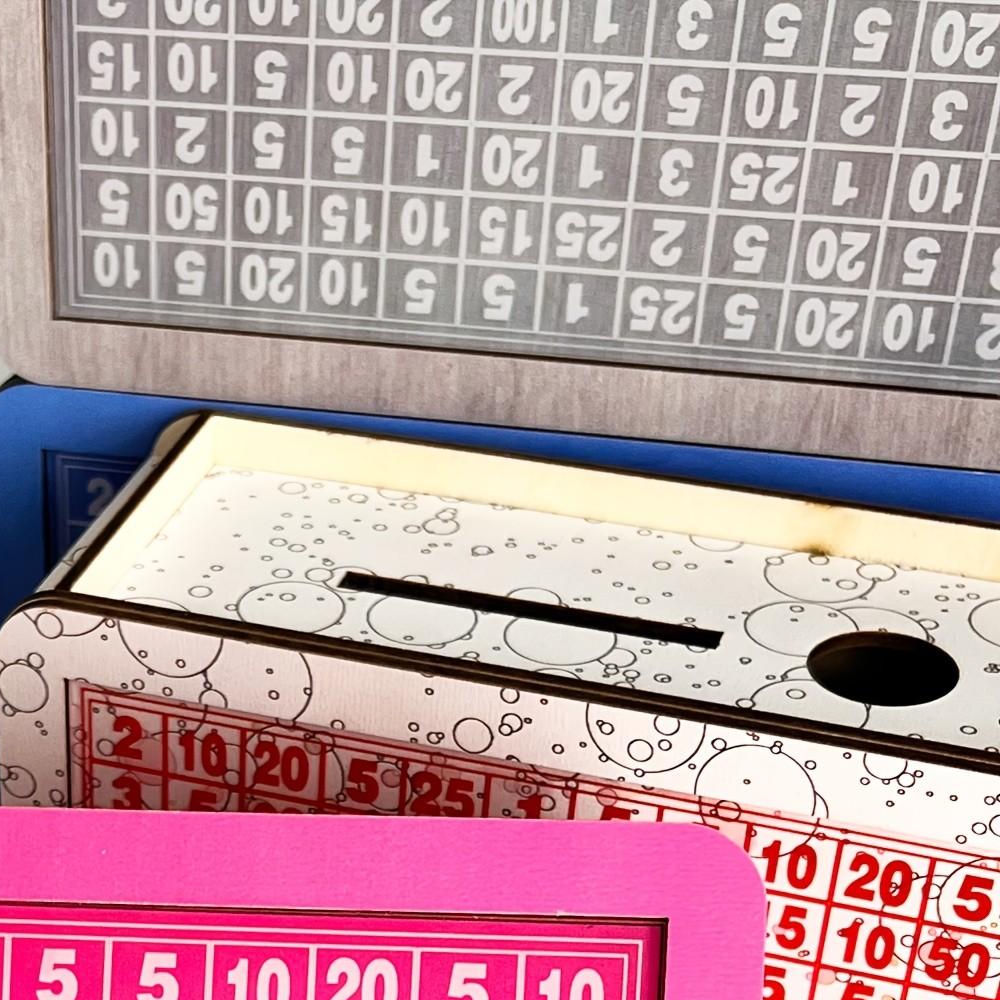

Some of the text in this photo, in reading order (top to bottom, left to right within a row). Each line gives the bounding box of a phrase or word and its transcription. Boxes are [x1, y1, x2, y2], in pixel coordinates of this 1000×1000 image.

[91, 107, 964, 214] 10 1 25 3 1 20 1 5 5 2 10
[98, 178, 130, 226] 5
[165, 182, 218, 232] 50
[244, 186, 293, 235] 10
[321, 194, 372, 244] 15
[400, 198, 451, 247] 10
[479, 206, 532, 256] 15
[555, 211, 621, 262] 25
[649, 218, 687, 267] 2
[733, 224, 770, 274] 5
[806, 228, 872, 282] 20
[94, 241, 141, 289] 10
[174, 250, 206, 296] 5
[240, 254, 295, 304] 20
[319, 259, 368, 307] 10
[902, 236, 942, 287] 5
[403, 268, 437, 315] 5
[482, 274, 516, 321] 5
[565, 282, 590, 324] 1
[629, 285, 695, 335] 25
[723, 293, 760, 341] 5
[795, 297, 859, 350] 20
[882, 303, 936, 353] 10
[113, 715, 143, 760] 2
[178, 730, 228, 777] 10
[254, 739, 309, 792] 20
[345, 758, 381, 804] 5
[411, 770, 477, 818] 25
[761, 839, 818, 891] 10
[844, 851, 914, 908] 20
[953, 874, 994, 922] 5
[838, 920, 896, 971] 10
[923, 934, 992, 989] 50
